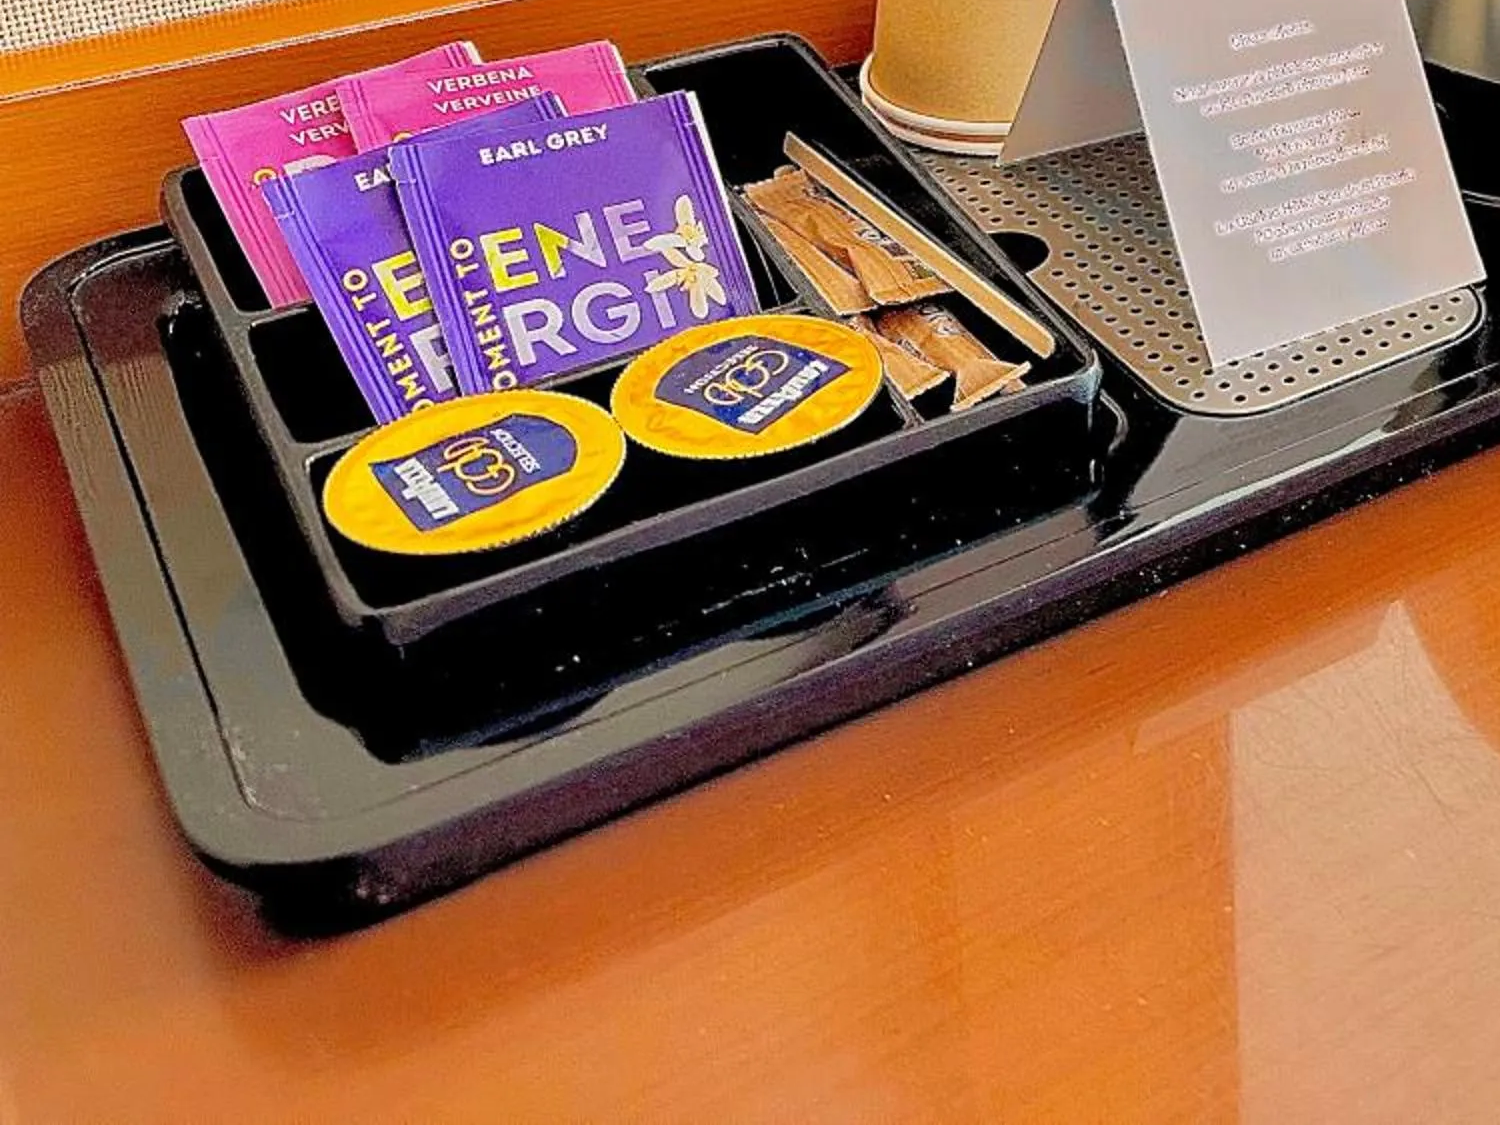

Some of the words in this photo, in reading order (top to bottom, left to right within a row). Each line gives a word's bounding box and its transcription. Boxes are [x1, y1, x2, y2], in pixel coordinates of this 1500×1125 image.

[427, 66, 534, 95] VERBENA
[433, 84, 542, 115] VERVEINE
[479, 139, 543, 166] EARL
[546, 123, 608, 151] GREY
[449, 238, 480, 280] TO
[479, 198, 656, 293] ENE
[342, 268, 378, 312] TO
[464, 288, 518, 391] OMENT
